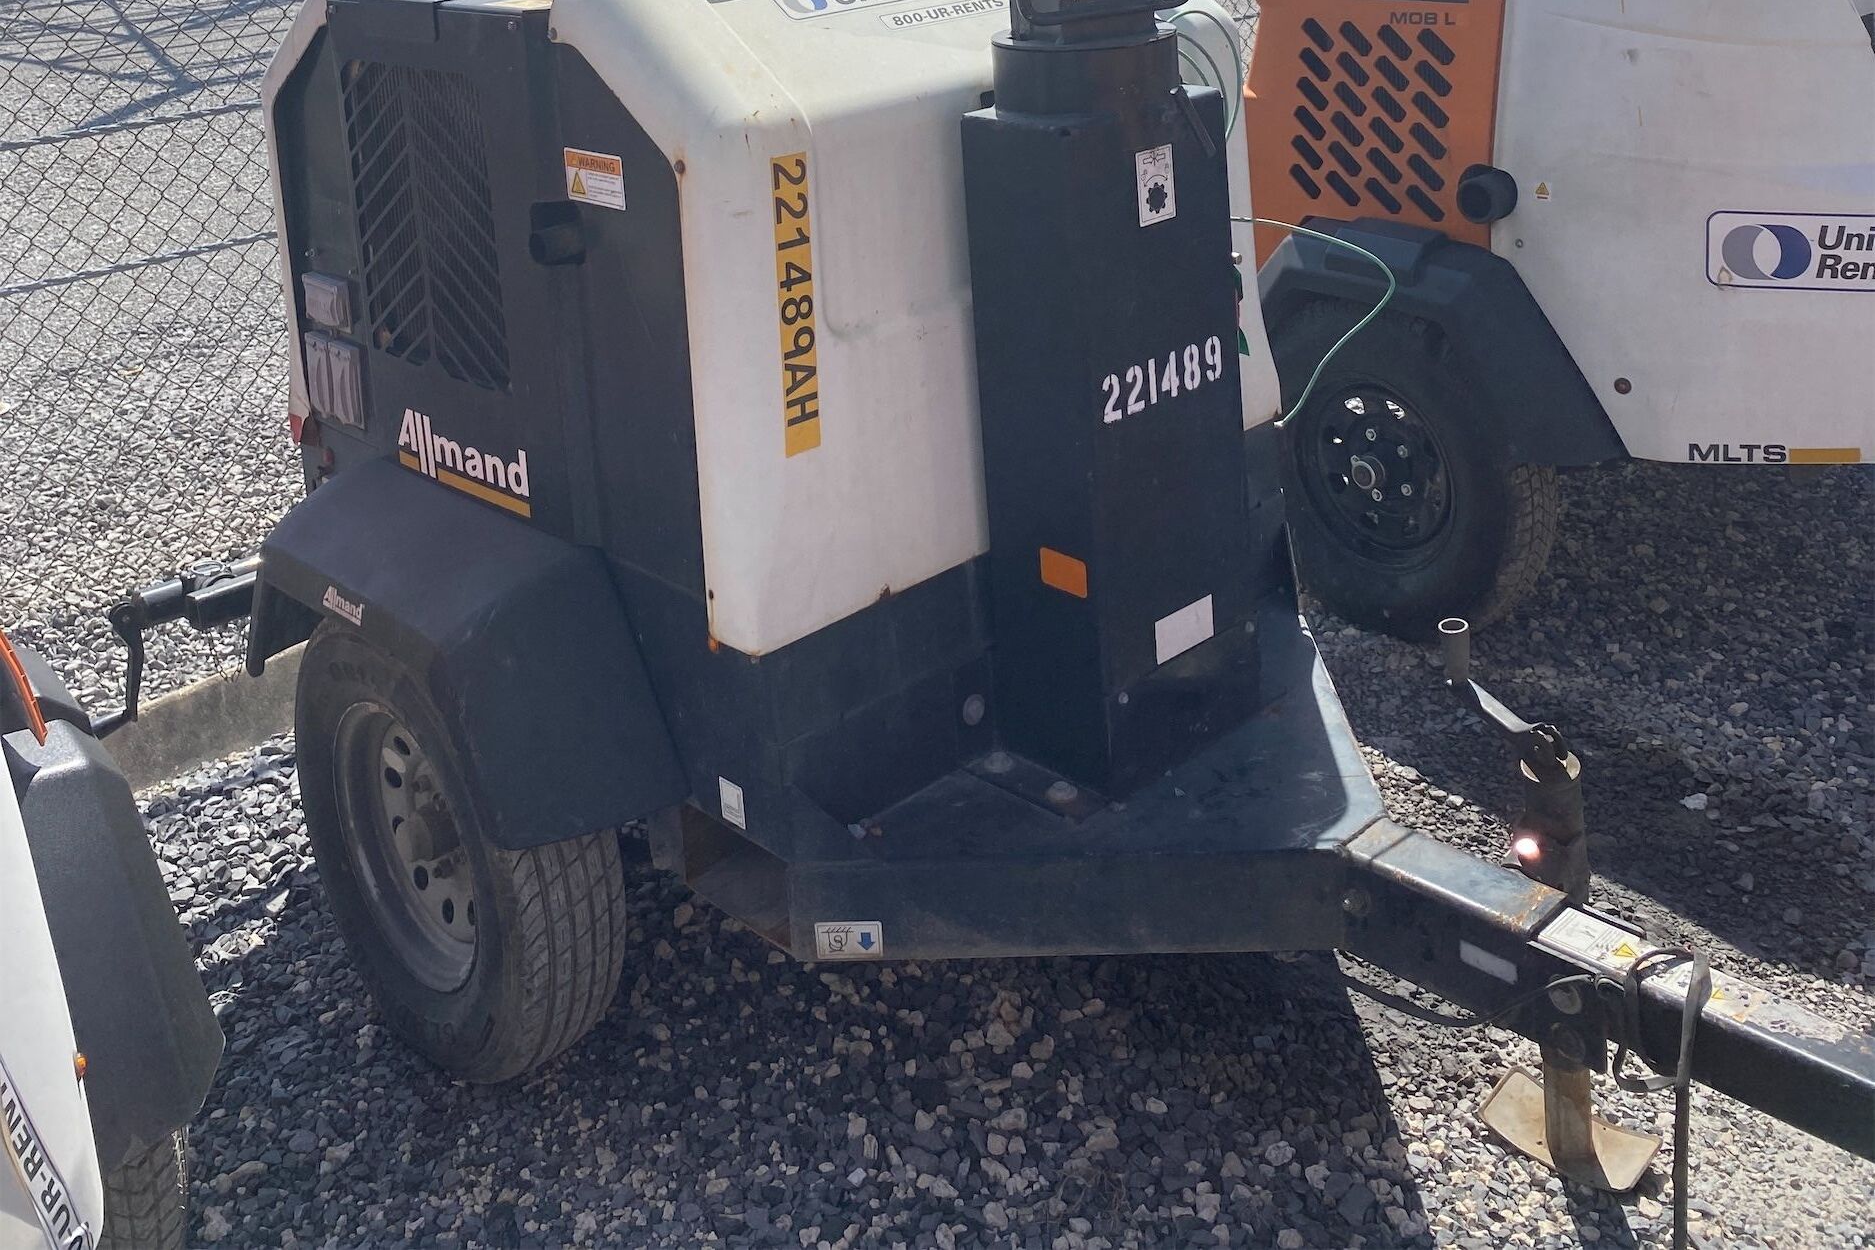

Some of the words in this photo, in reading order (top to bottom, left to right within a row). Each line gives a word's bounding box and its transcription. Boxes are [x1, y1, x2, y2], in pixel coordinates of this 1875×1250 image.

[577, 155, 616, 173] WARNING
[772, 158, 820, 428] 221489AH
[1102, 335, 1223, 424] 221489
[397, 407, 531, 498] Allmand
[1687, 442, 1787, 463] MLTS
[323, 585, 363, 620] Allmand
